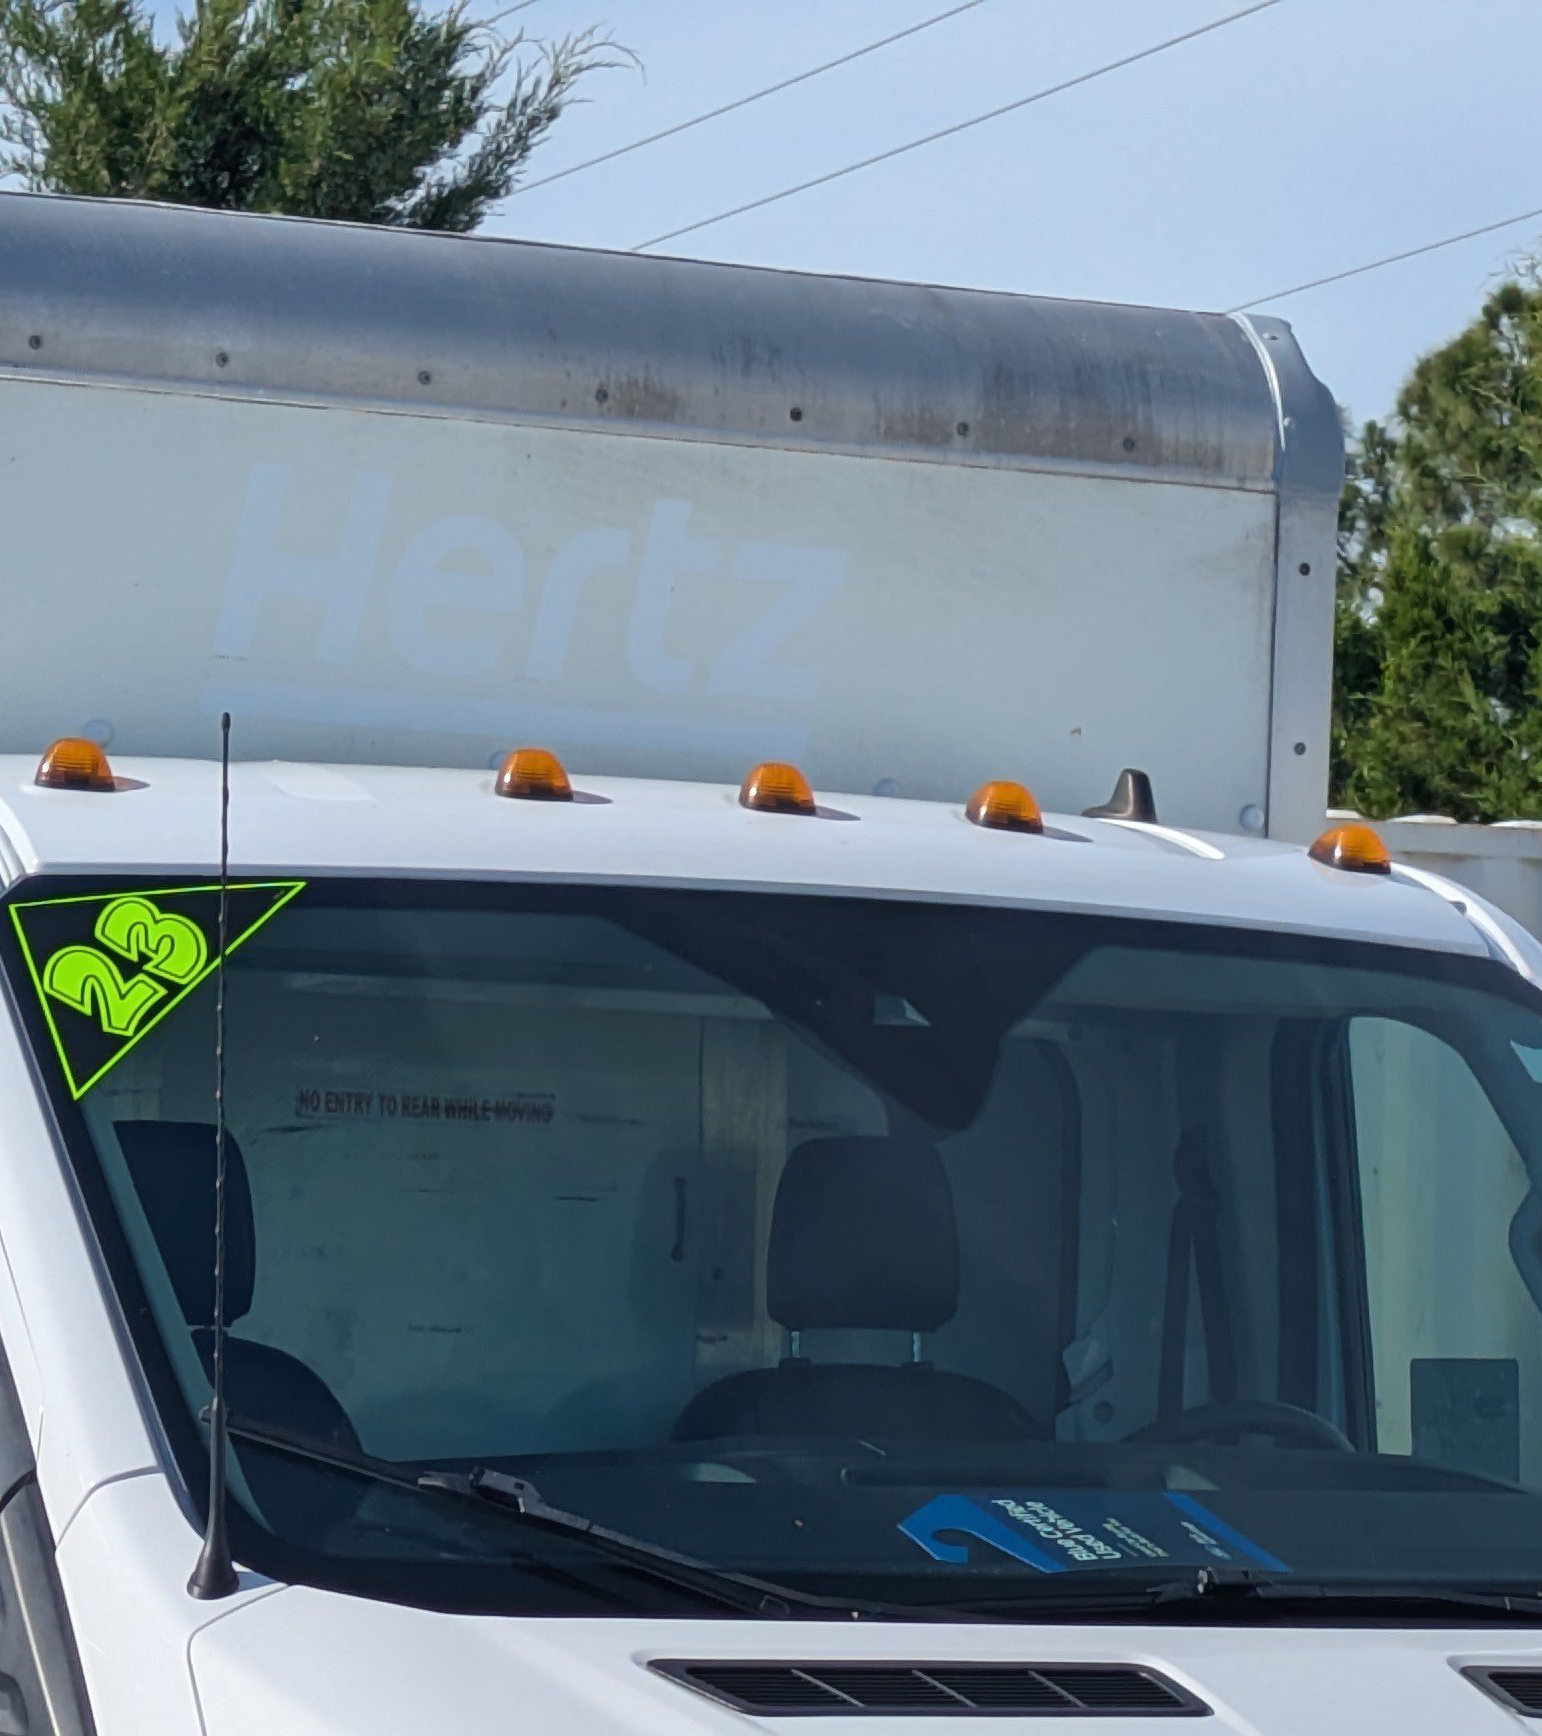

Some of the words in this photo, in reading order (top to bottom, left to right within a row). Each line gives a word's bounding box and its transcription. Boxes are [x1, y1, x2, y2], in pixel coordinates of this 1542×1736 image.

[213, 463, 851, 698] Hertz
[43, 896, 207, 1037] 23
[299, 1090, 319, 1113] NO
[325, 1090, 373, 1114] ENTRY
[378, 1094, 397, 1117] TO
[401, 1095, 441, 1119] REAR
[1057, 1539, 1099, 1561] Blue
[1070, 1534, 1121, 1559] Used
